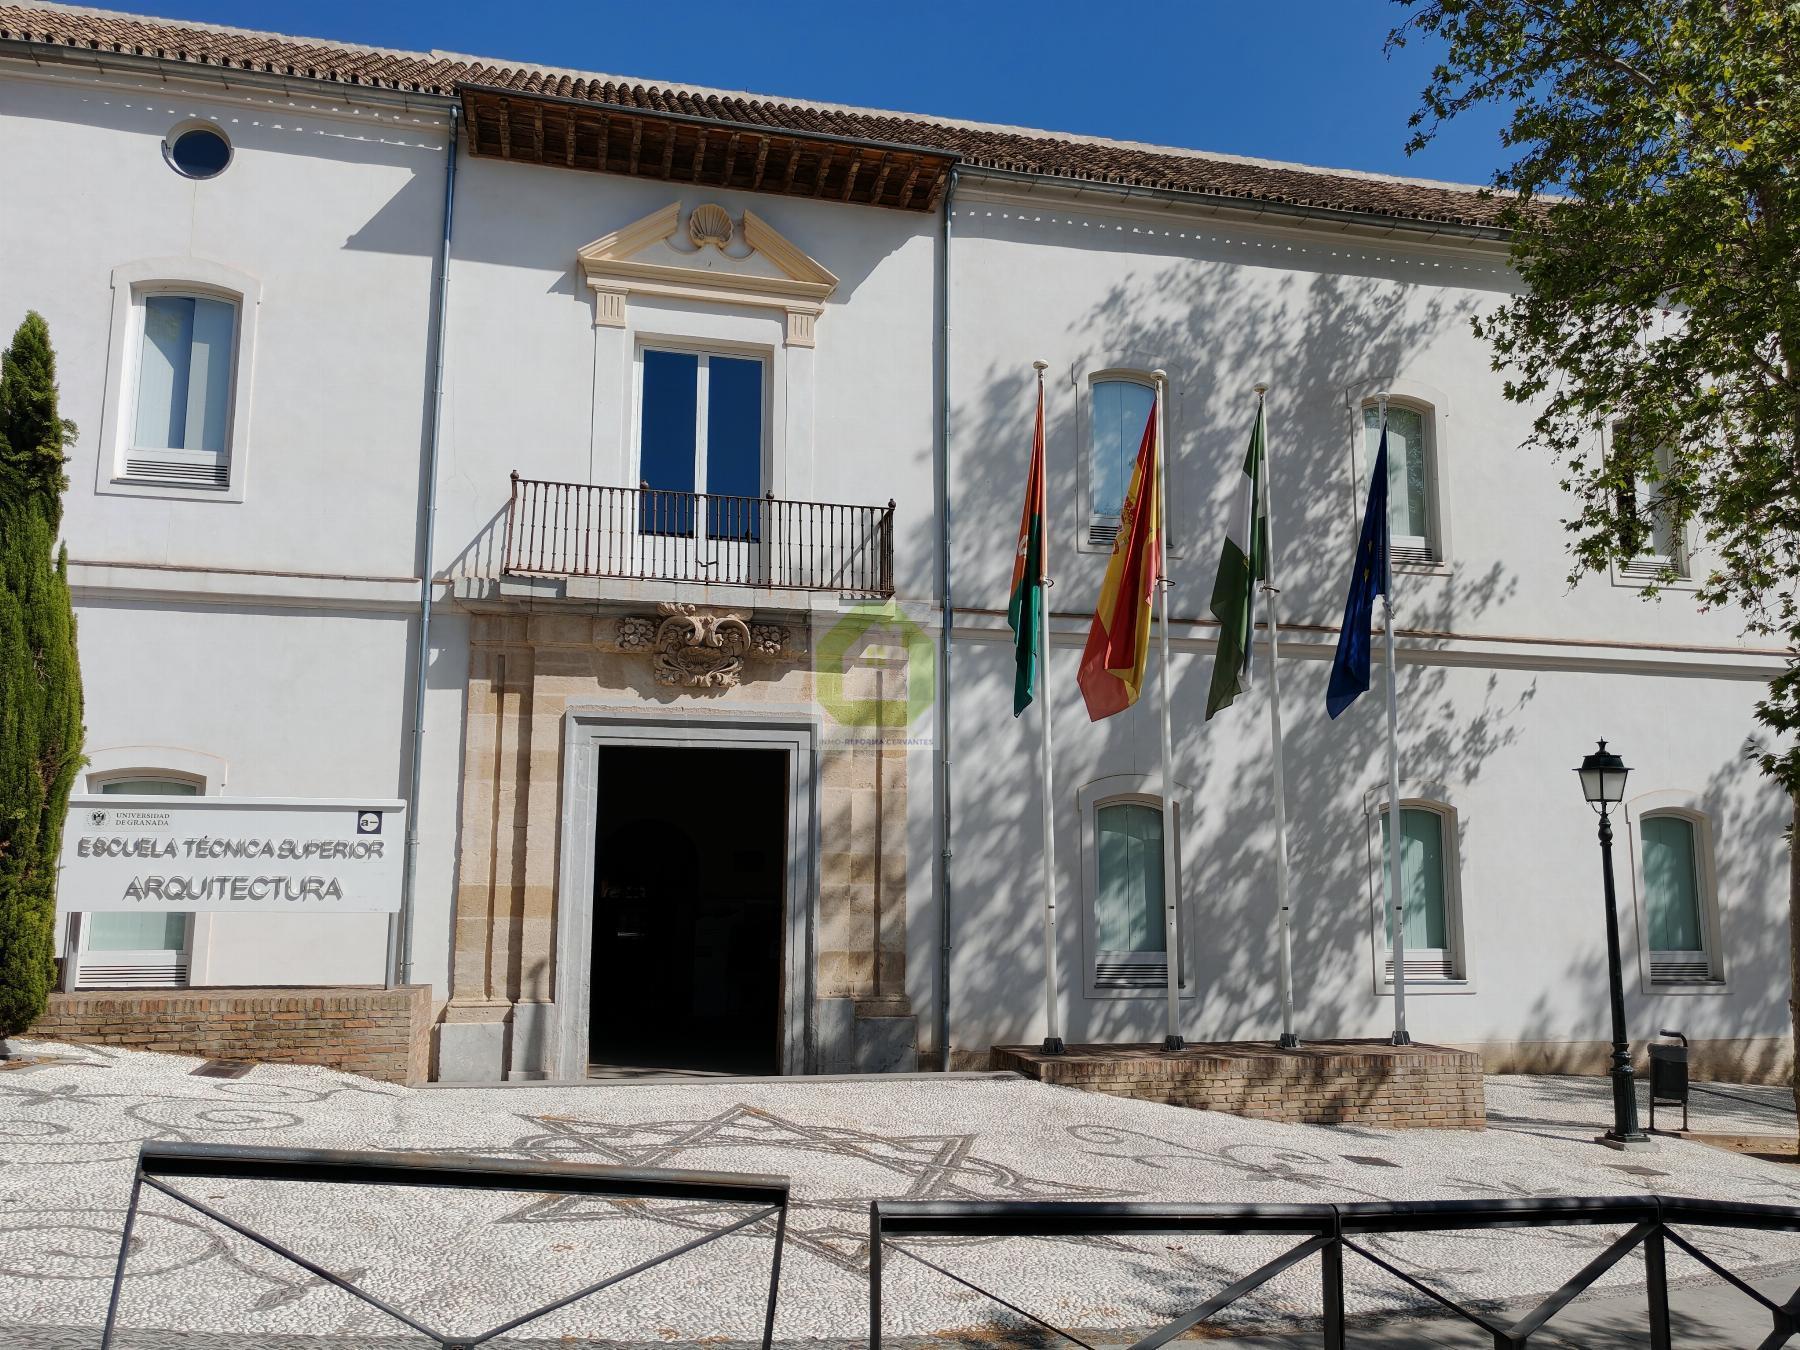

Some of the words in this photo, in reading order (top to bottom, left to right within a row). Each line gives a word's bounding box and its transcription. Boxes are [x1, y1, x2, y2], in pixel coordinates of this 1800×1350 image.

[77, 837, 178, 859] ESCUELA
[182, 835, 275, 859] TÉCNICA
[277, 838, 385, 860] SUPERIOR
[122, 875, 344, 902] ARQUITECTURA
